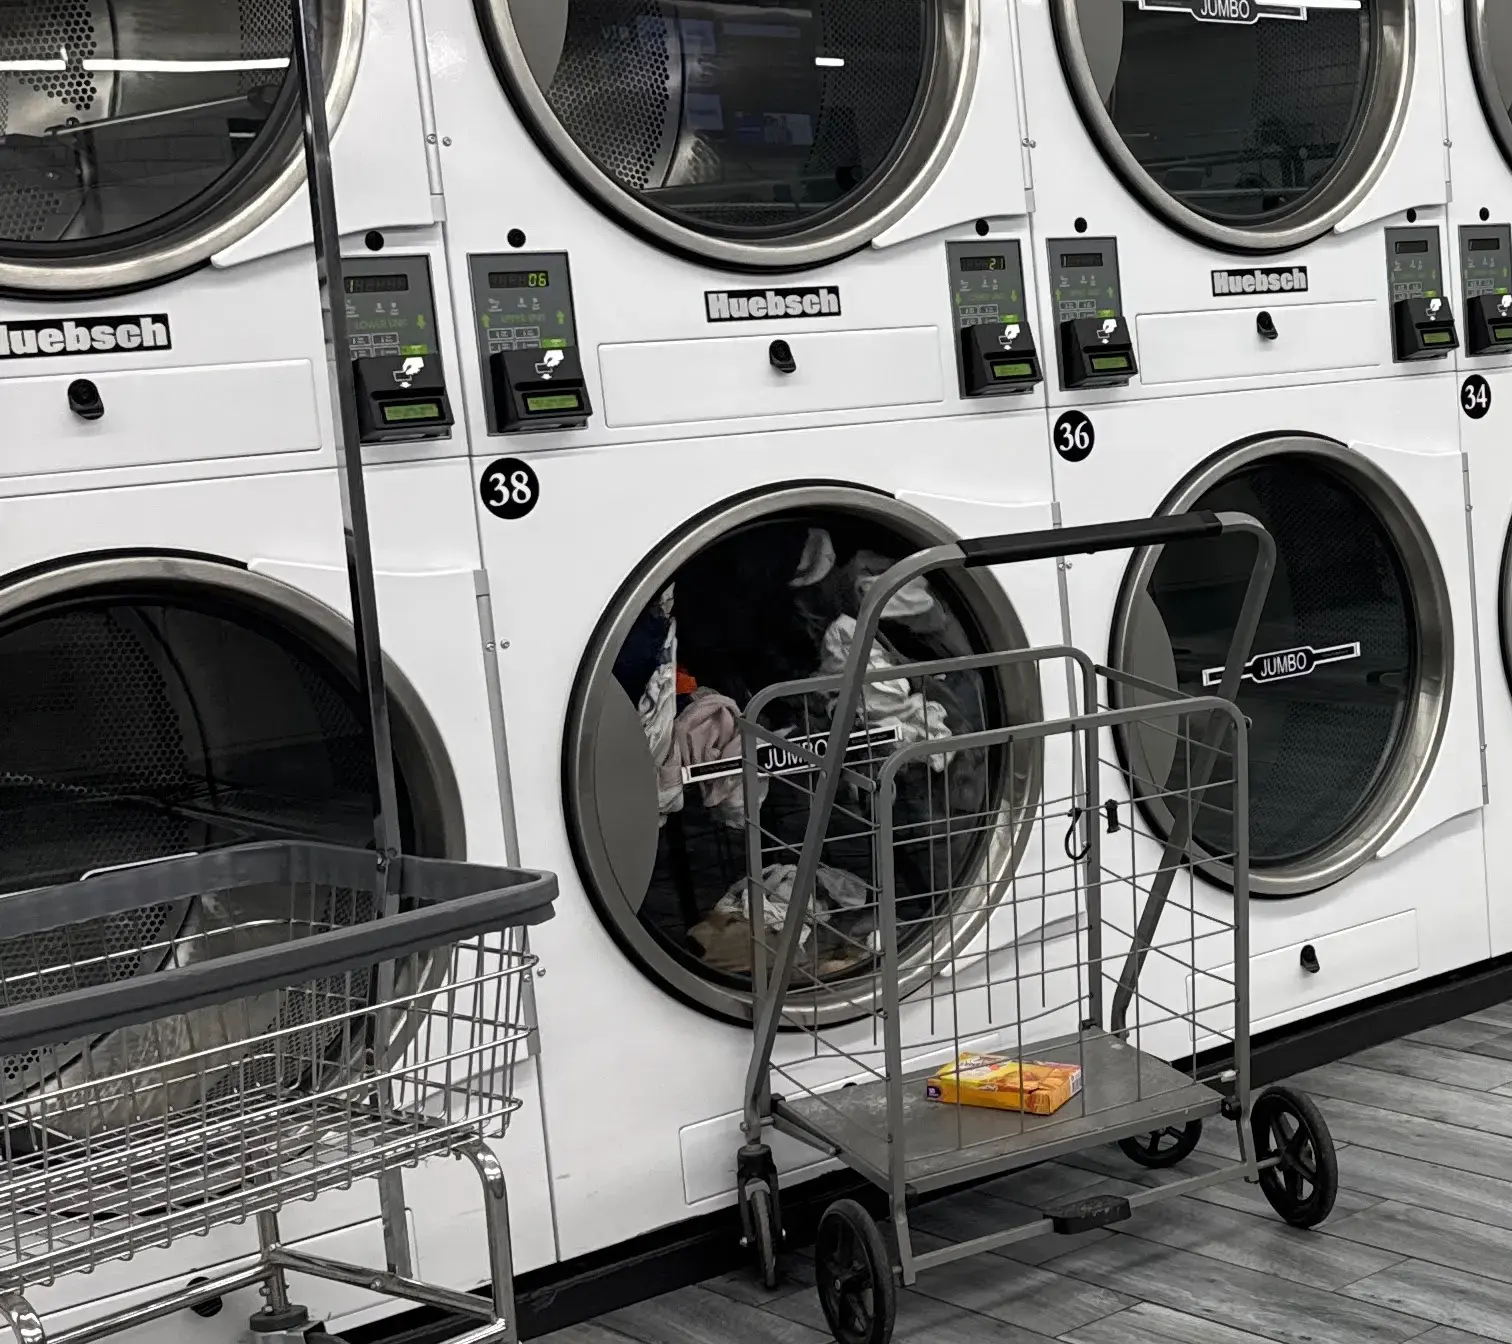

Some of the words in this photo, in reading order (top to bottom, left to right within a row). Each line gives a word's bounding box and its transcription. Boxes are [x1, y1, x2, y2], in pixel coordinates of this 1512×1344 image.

[528, 273, 547, 287] 06
[1213, 268, 1307, 294] Huebsch
[708, 288, 839, 319] Huebsch
[1465, 384, 1488, 410] 34
[1060, 421, 1090, 451] 36
[489, 471, 531, 506] 38
[1261, 652, 1306, 677] JUMBO
